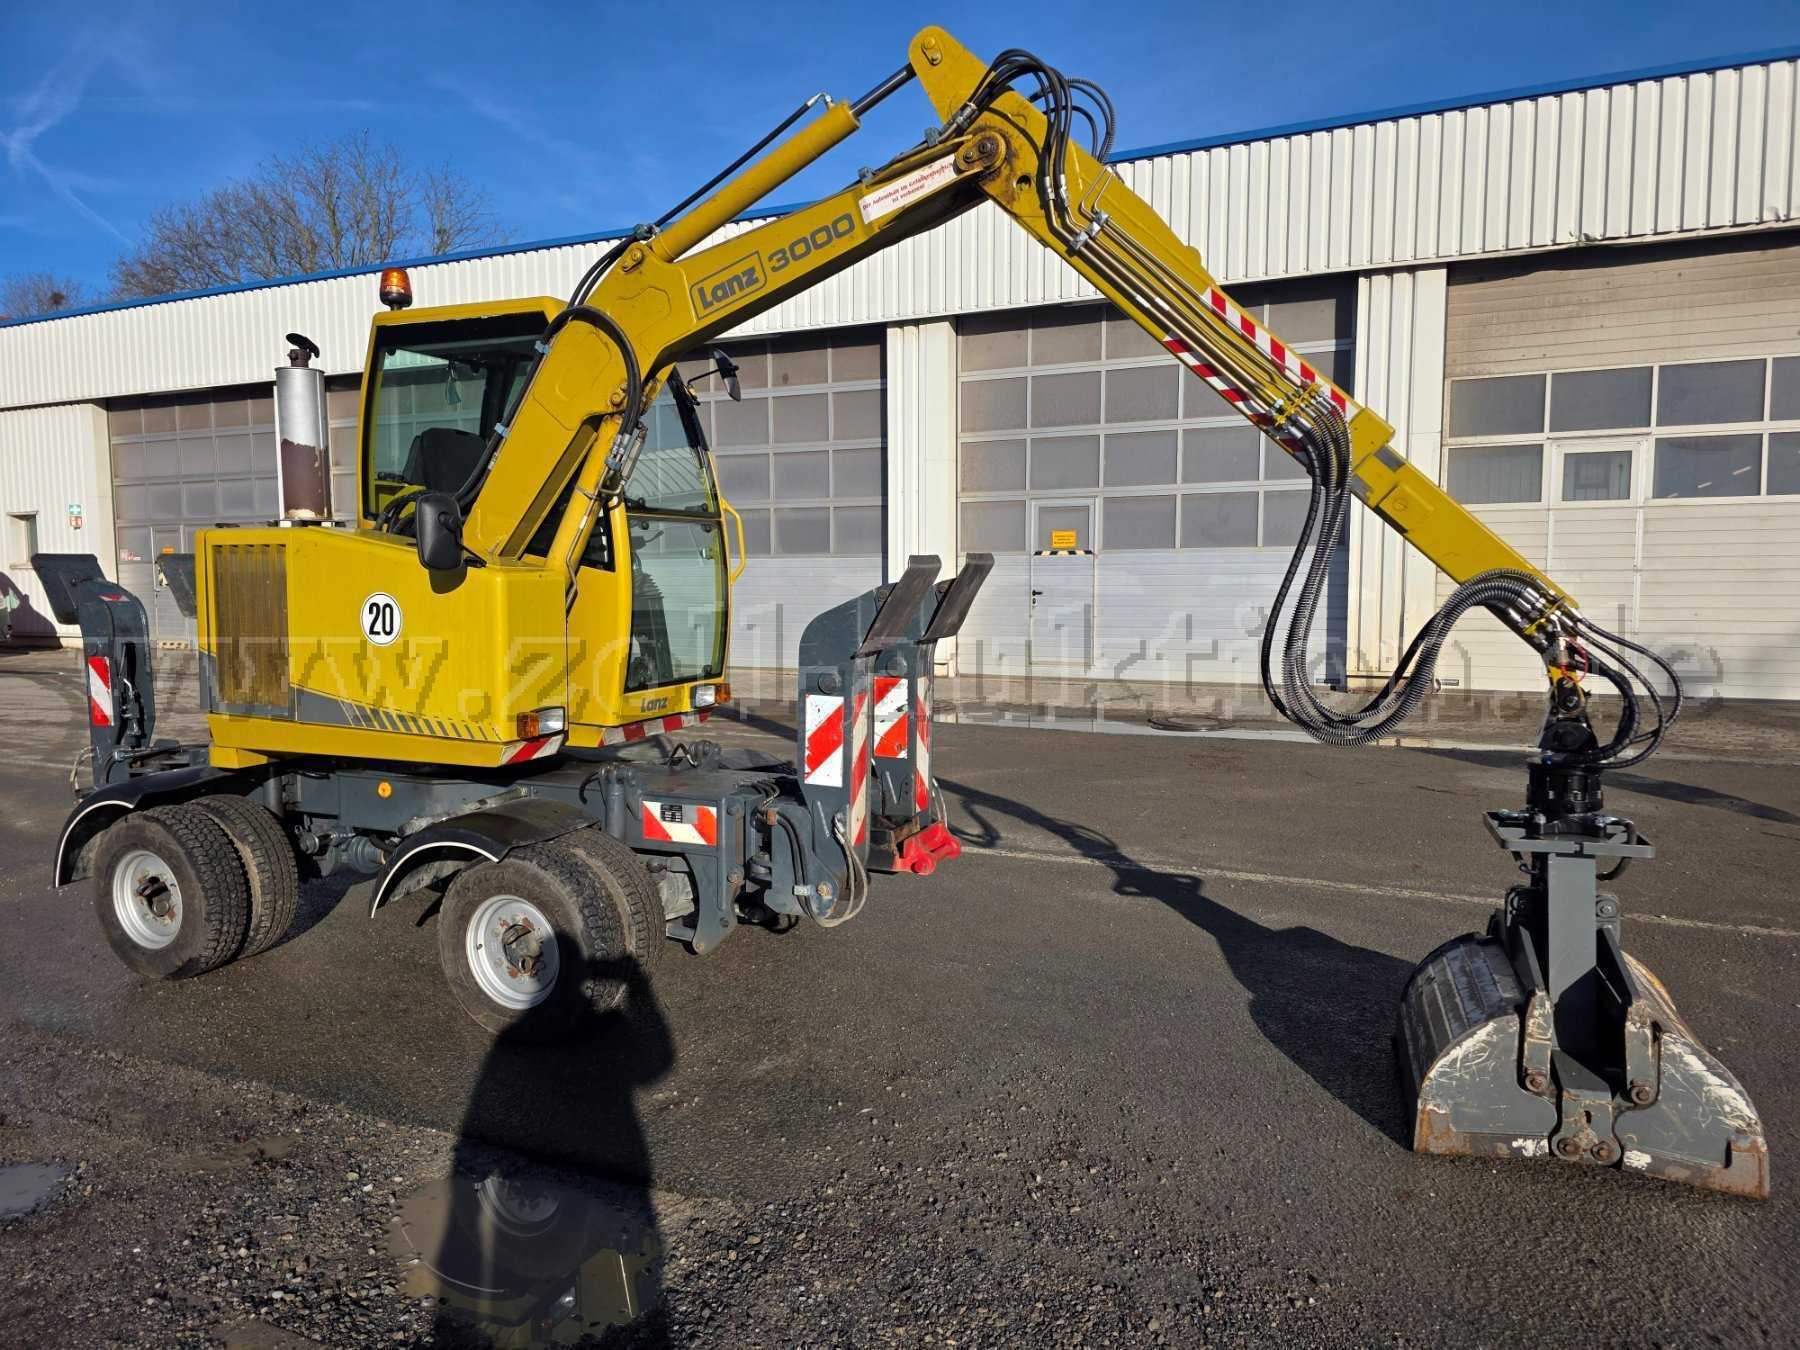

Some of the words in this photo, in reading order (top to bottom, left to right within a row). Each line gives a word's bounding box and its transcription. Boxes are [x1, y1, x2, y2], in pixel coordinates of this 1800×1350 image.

[697, 267, 759, 310] Lanz
[767, 212, 856, 273] 3000
[368, 602, 394, 636] 20
[640, 696, 669, 713] Lanz
